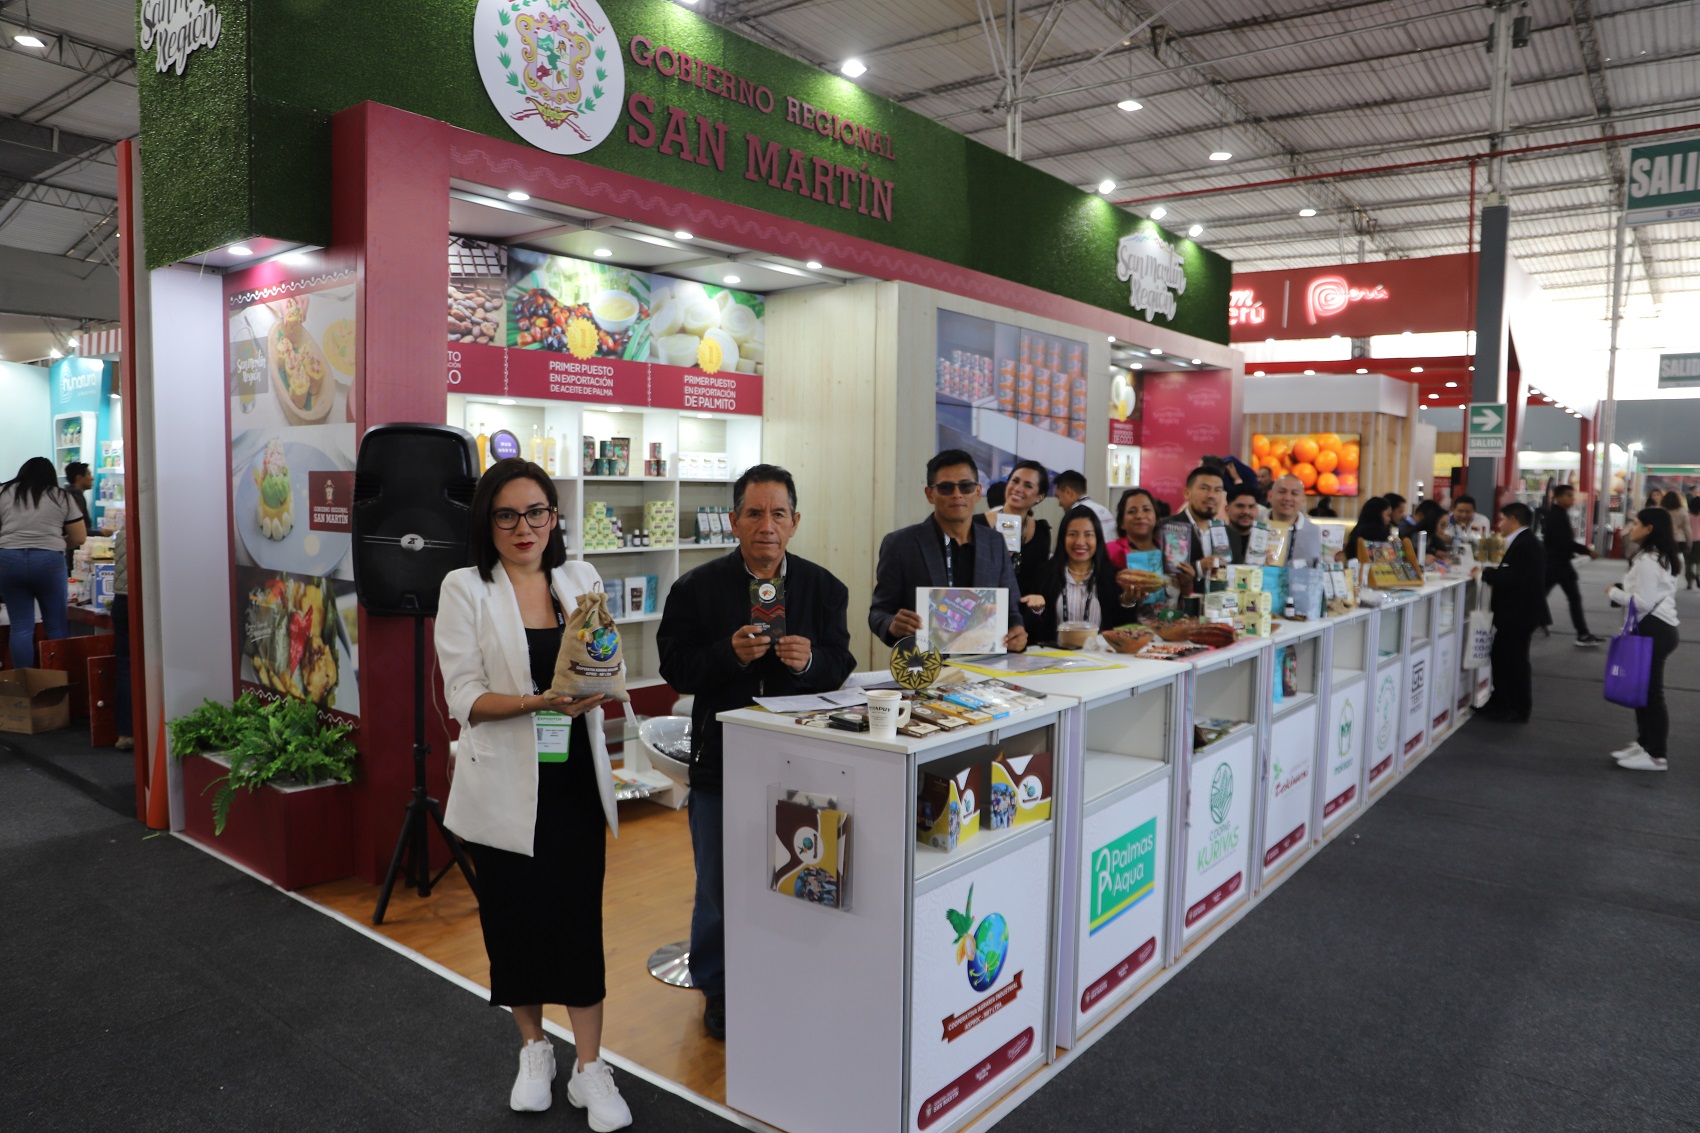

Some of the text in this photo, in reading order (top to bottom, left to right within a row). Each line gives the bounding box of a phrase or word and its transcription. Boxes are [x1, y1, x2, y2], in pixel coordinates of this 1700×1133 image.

[157, 4, 220, 68] Región
[630, 35, 896, 160] GOBIERNO REGIONAL
[628, 92, 895, 222] SAN MARTÍN
[1630, 151, 1700, 198] SALI
[549, 360, 614, 376] PRIMER PUESTO
[549, 373, 614, 387] EN EXPORTACIÓN
[684, 375, 736, 389] PRIMER PUESTO
[550, 384, 613, 396] DE ACEITE DE PALMA
[684, 386, 736, 398] EN EXPORTACIÓN
[684, 395, 736, 410] DE PALMITO
[1471, 438, 1503, 448] SALIDA
[314, 513, 348, 524] SAN MARTÍN
[1111, 834, 1154, 872] Palmas
[1113, 862, 1145, 896] Aqua
[948, 1008, 978, 1031] COOPERATIVA
